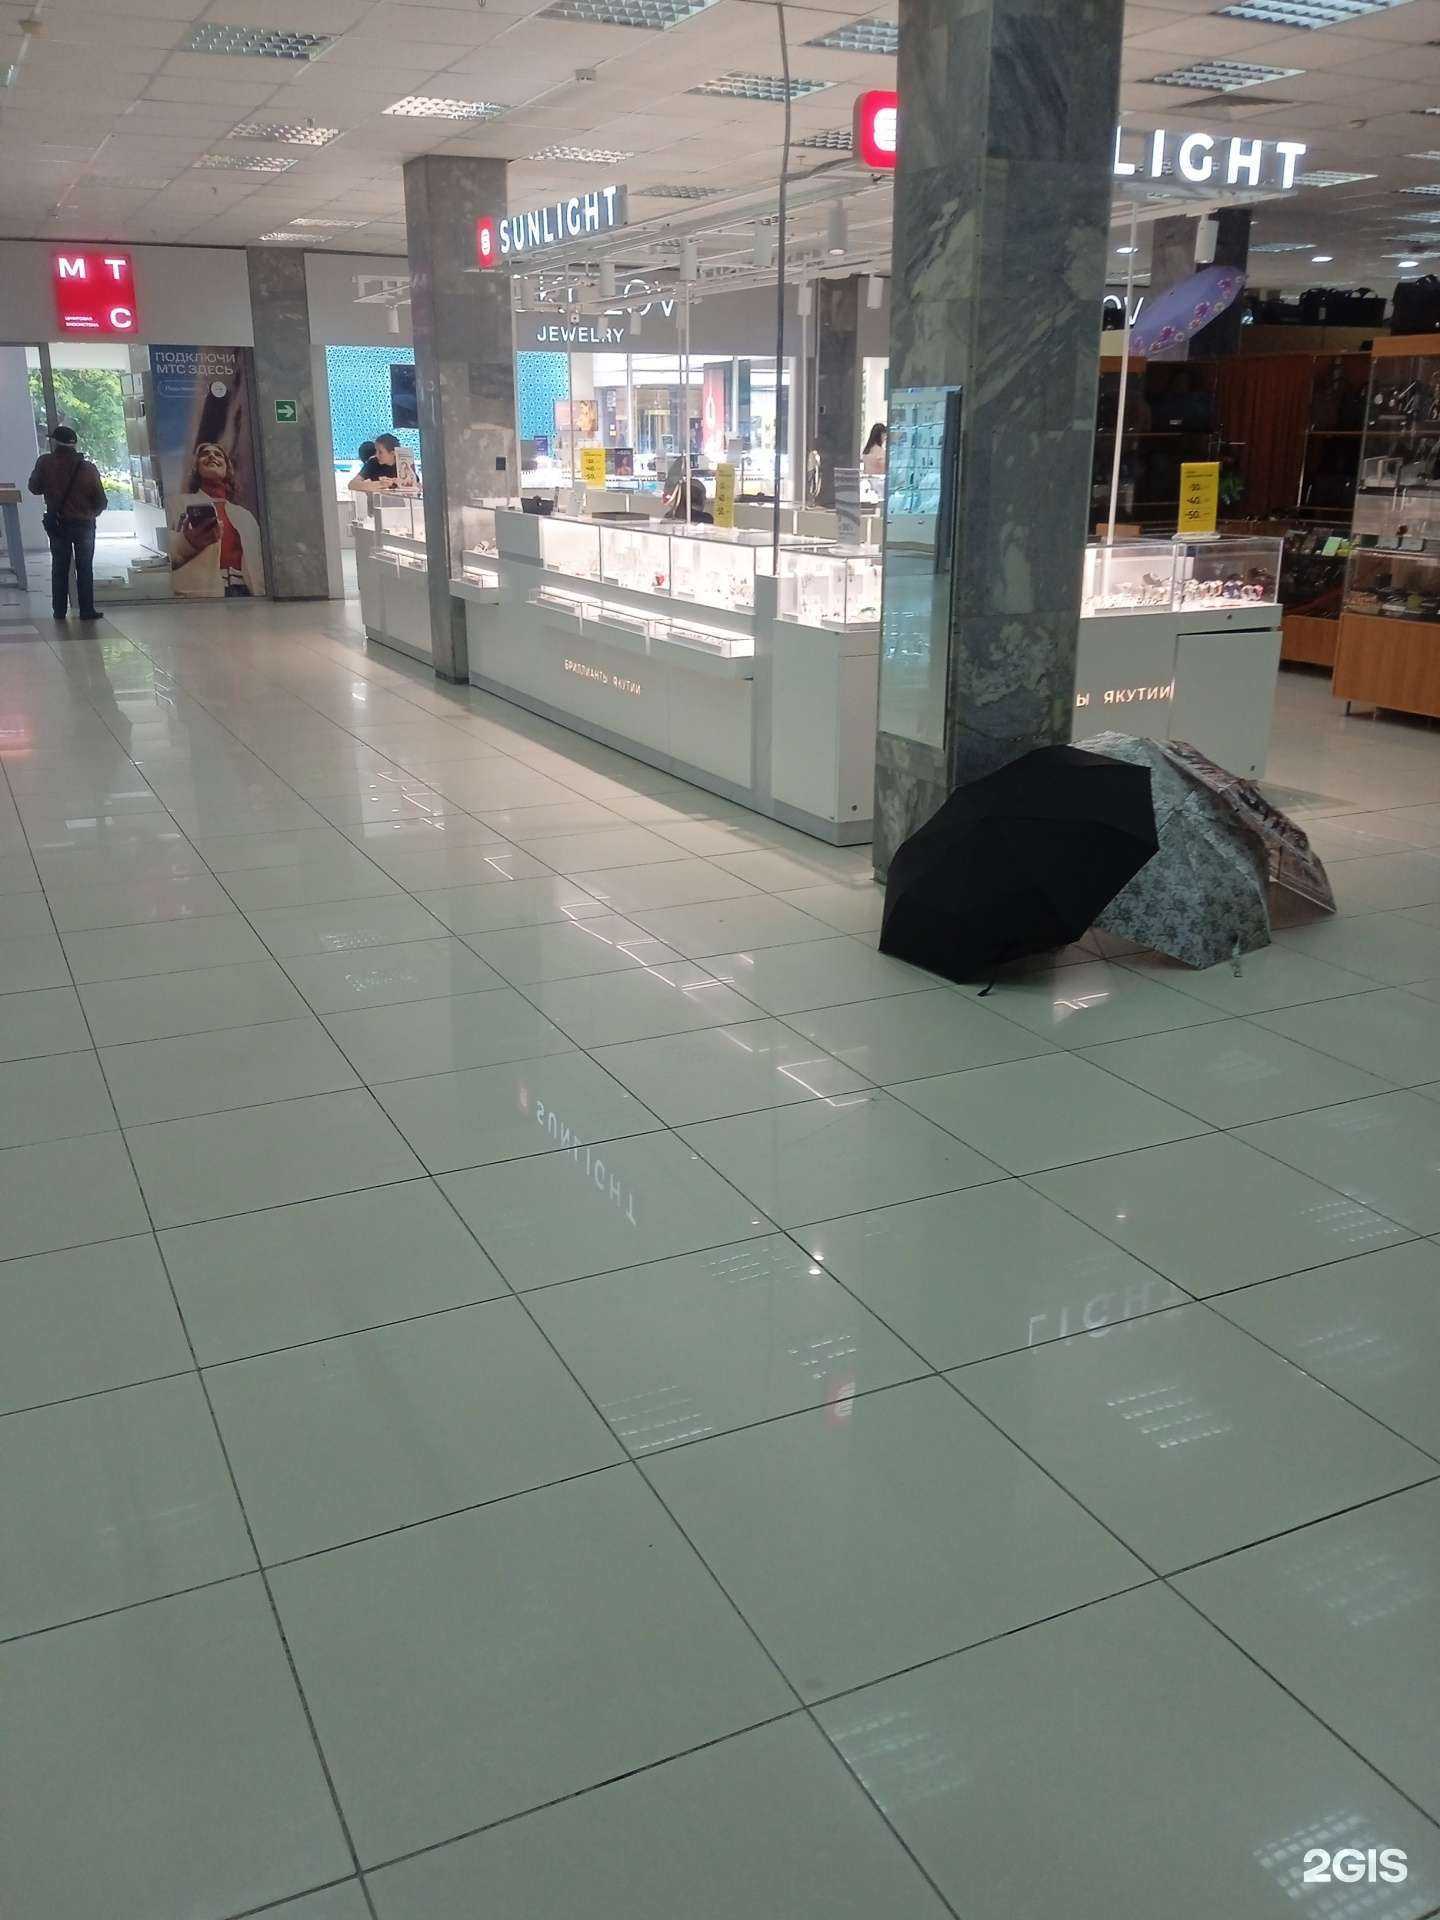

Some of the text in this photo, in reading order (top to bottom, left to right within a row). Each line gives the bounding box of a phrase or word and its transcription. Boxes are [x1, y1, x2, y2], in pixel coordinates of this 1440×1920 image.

[500, 185, 617, 254] SUNLIGHT
[536, 325, 624, 344] JEWELRY
[155, 352, 236, 364] ПОДКЛЮЧИ
[156, 364, 234, 377] МТС ЗДЕСЬ
[1103, 684, 1171, 704] ЯКУТИИ
